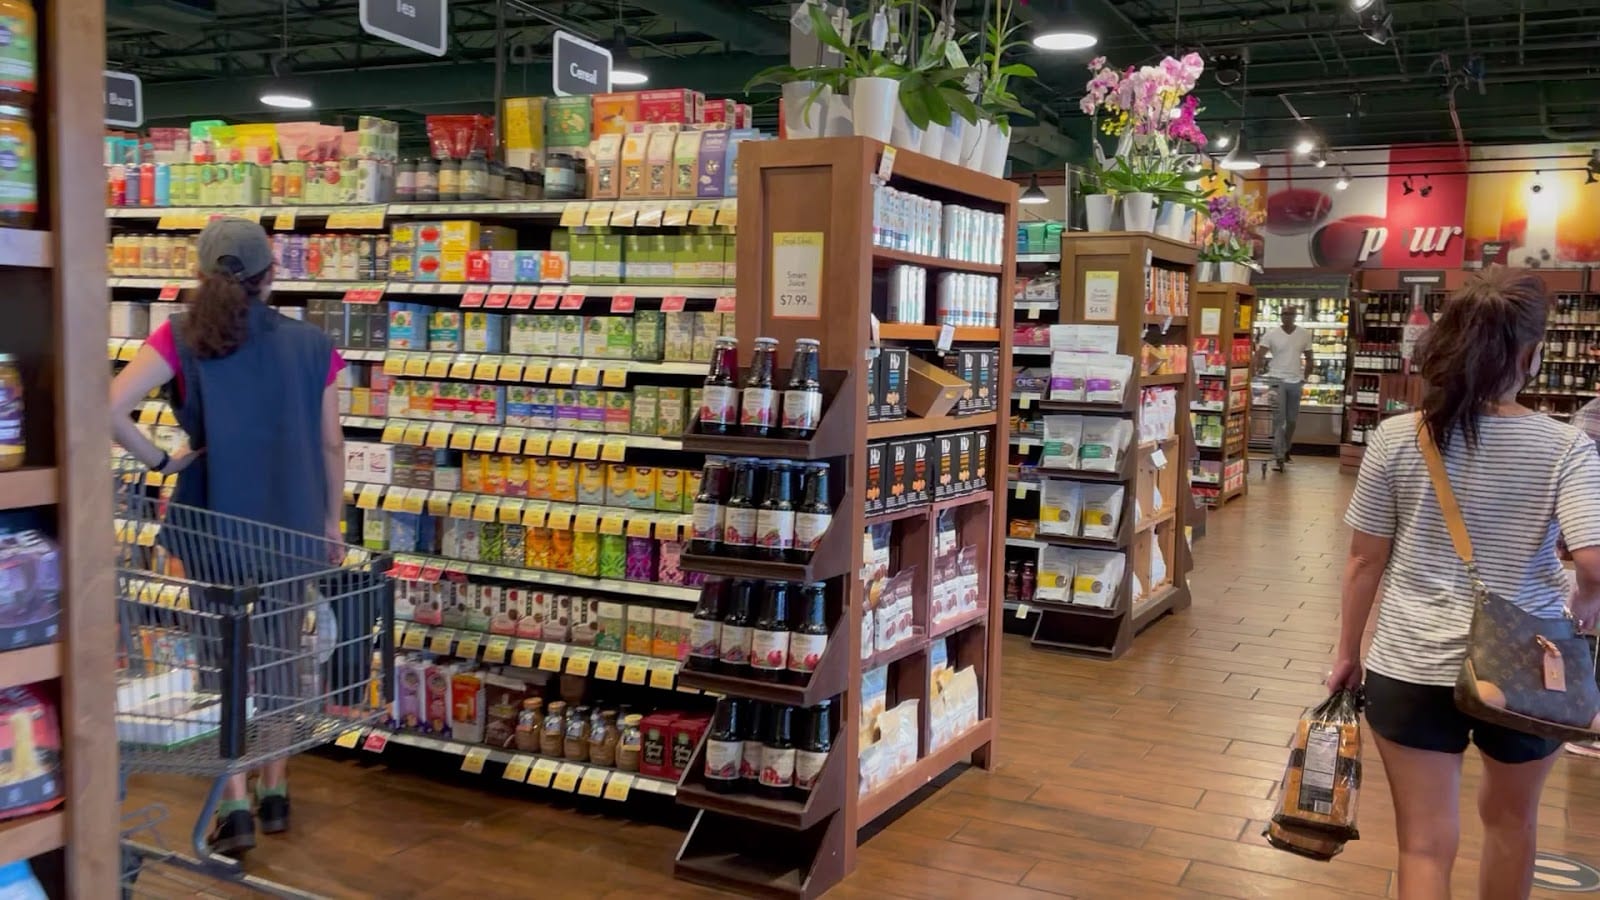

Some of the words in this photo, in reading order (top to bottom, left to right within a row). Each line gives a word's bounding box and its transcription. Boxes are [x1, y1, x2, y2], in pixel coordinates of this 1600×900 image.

[569, 62, 598, 84] Cereal
[109, 92, 134, 107] Bars
[1358, 225, 1463, 262] pur
[786, 271, 807, 279] Smart
[787, 279, 805, 287] Juice
[780, 294, 807, 306] $7.99
